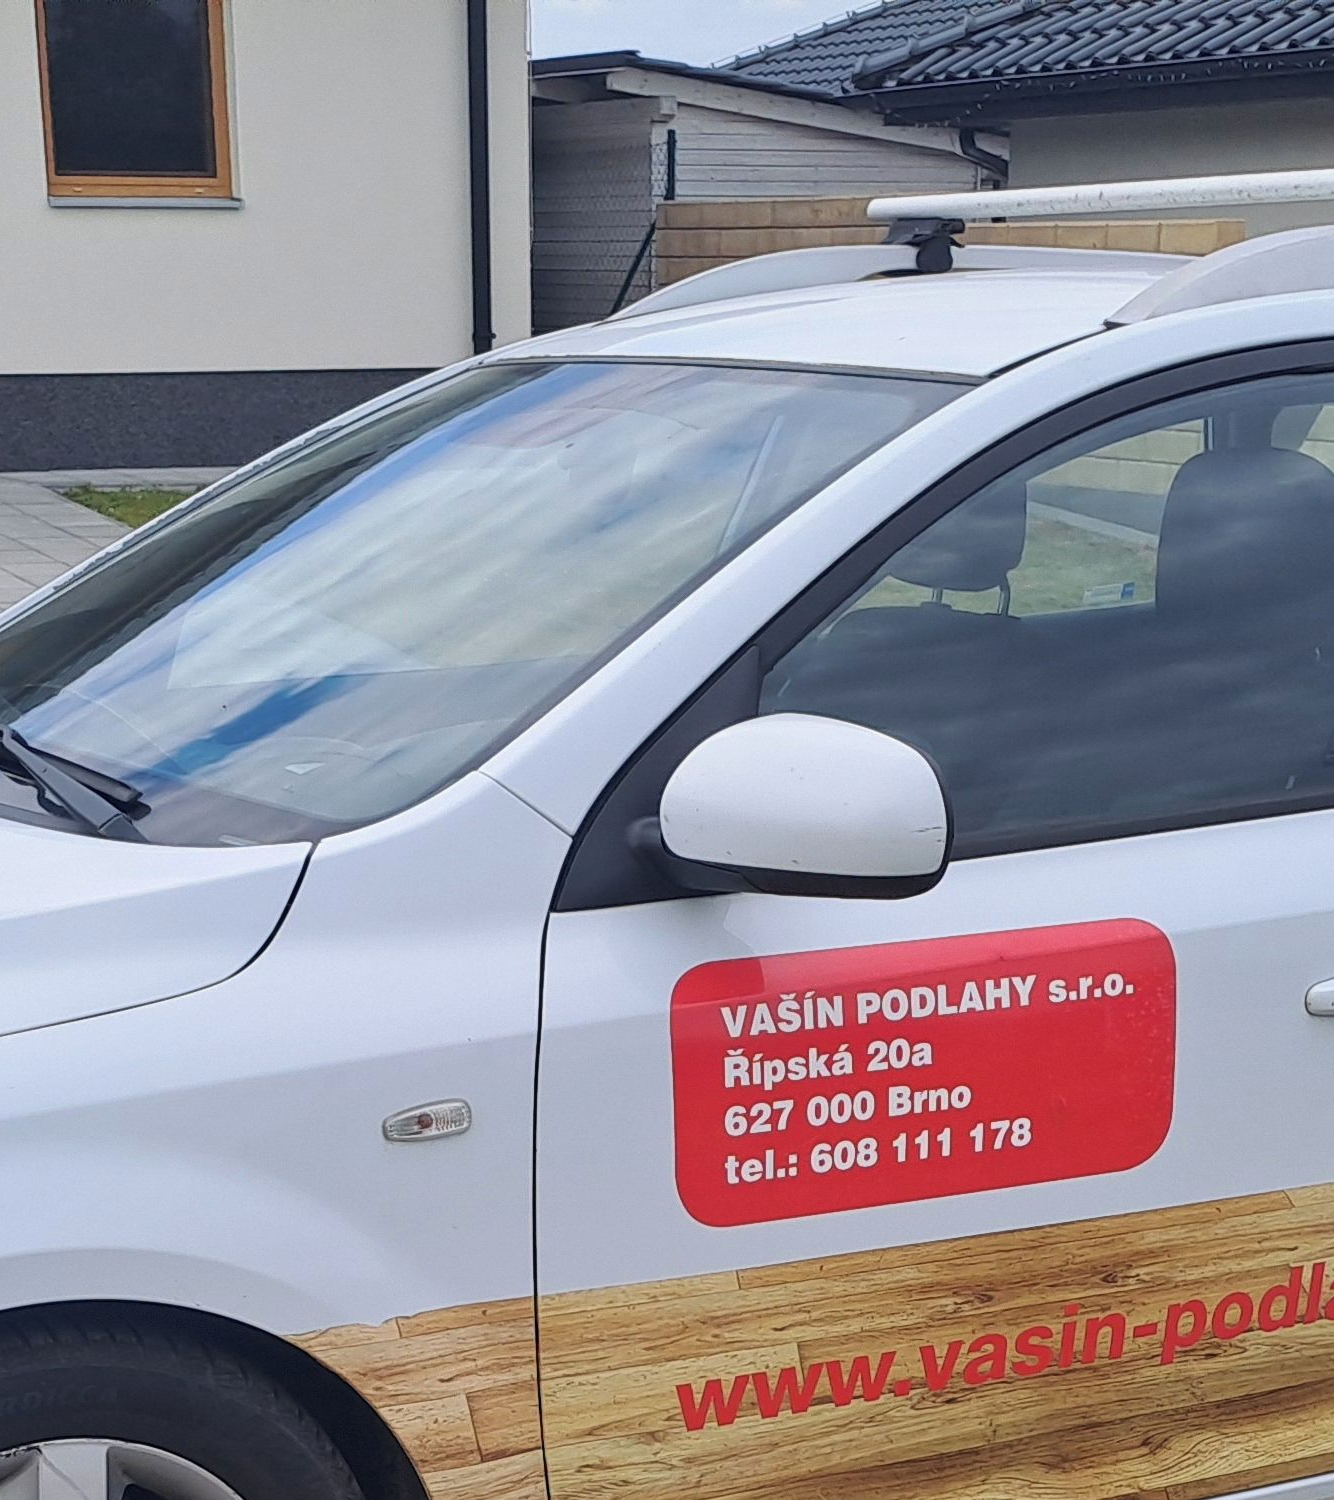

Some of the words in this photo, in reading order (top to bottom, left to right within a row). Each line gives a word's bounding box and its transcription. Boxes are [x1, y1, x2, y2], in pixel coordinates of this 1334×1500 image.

[720, 990, 844, 1038] VAŠÍN
[856, 974, 1037, 1025] PODLAHY
[1048, 973, 1134, 1003] s.r.o.
[724, 1043, 853, 1091] Řípská
[866, 1038, 933, 1072] 20a
[724, 1099, 794, 1137] 627
[806, 1090, 875, 1127] 000
[888, 1084, 972, 1117] Brno
[724, 1149, 798, 1185] tel.:
[810, 1137, 878, 1174] 608
[892, 1127, 951, 1163] 111
[969, 1117, 1032, 1153] 178
